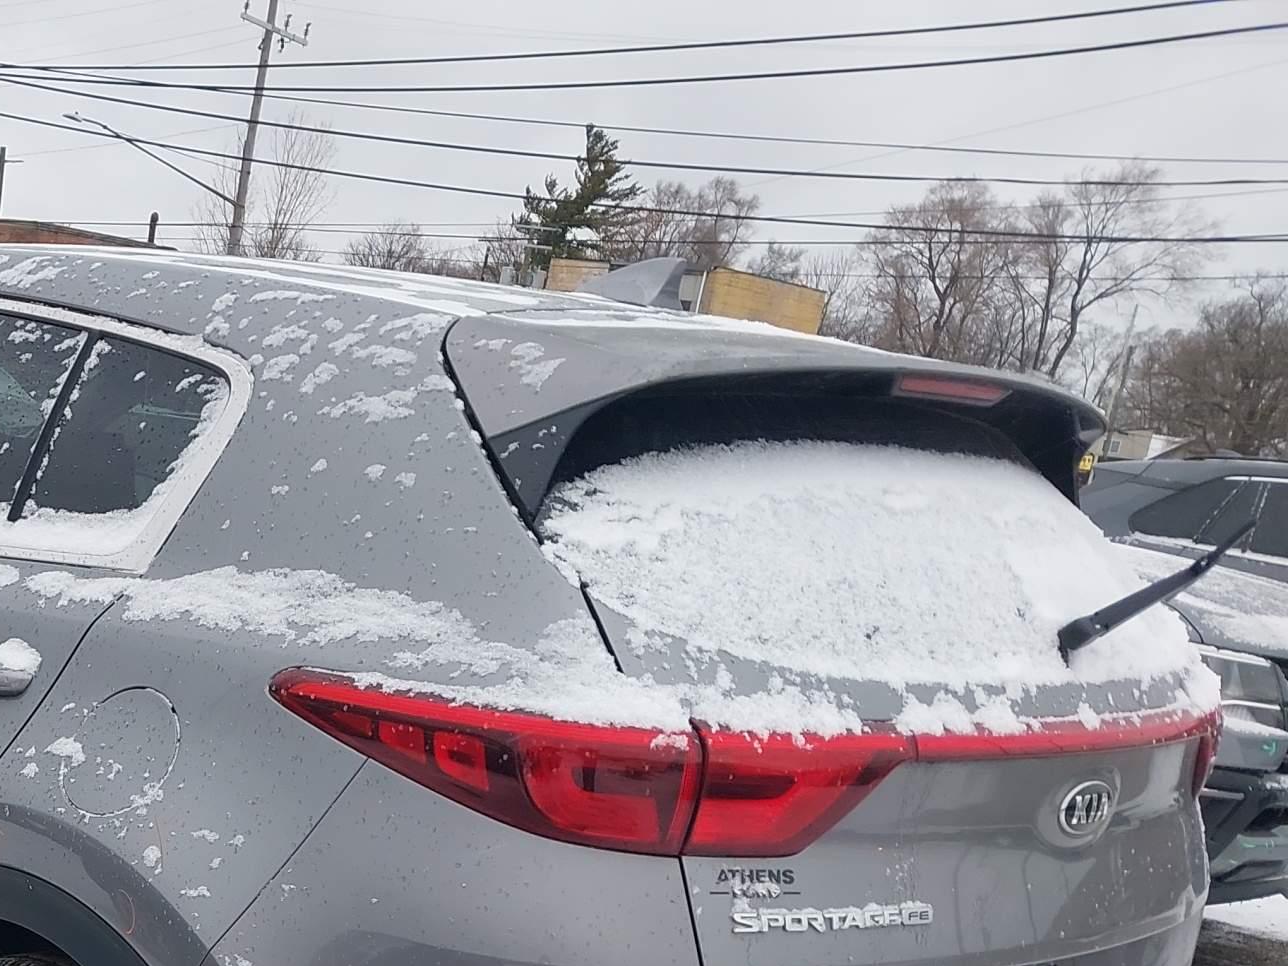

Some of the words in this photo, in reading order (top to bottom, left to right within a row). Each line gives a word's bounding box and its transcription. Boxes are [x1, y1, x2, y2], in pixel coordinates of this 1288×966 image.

[1071, 791, 1110, 825] KIA
[715, 868, 795, 885] ATHENS
[731, 906, 902, 933] SPORTAGE
[907, 910, 930, 922] FE
